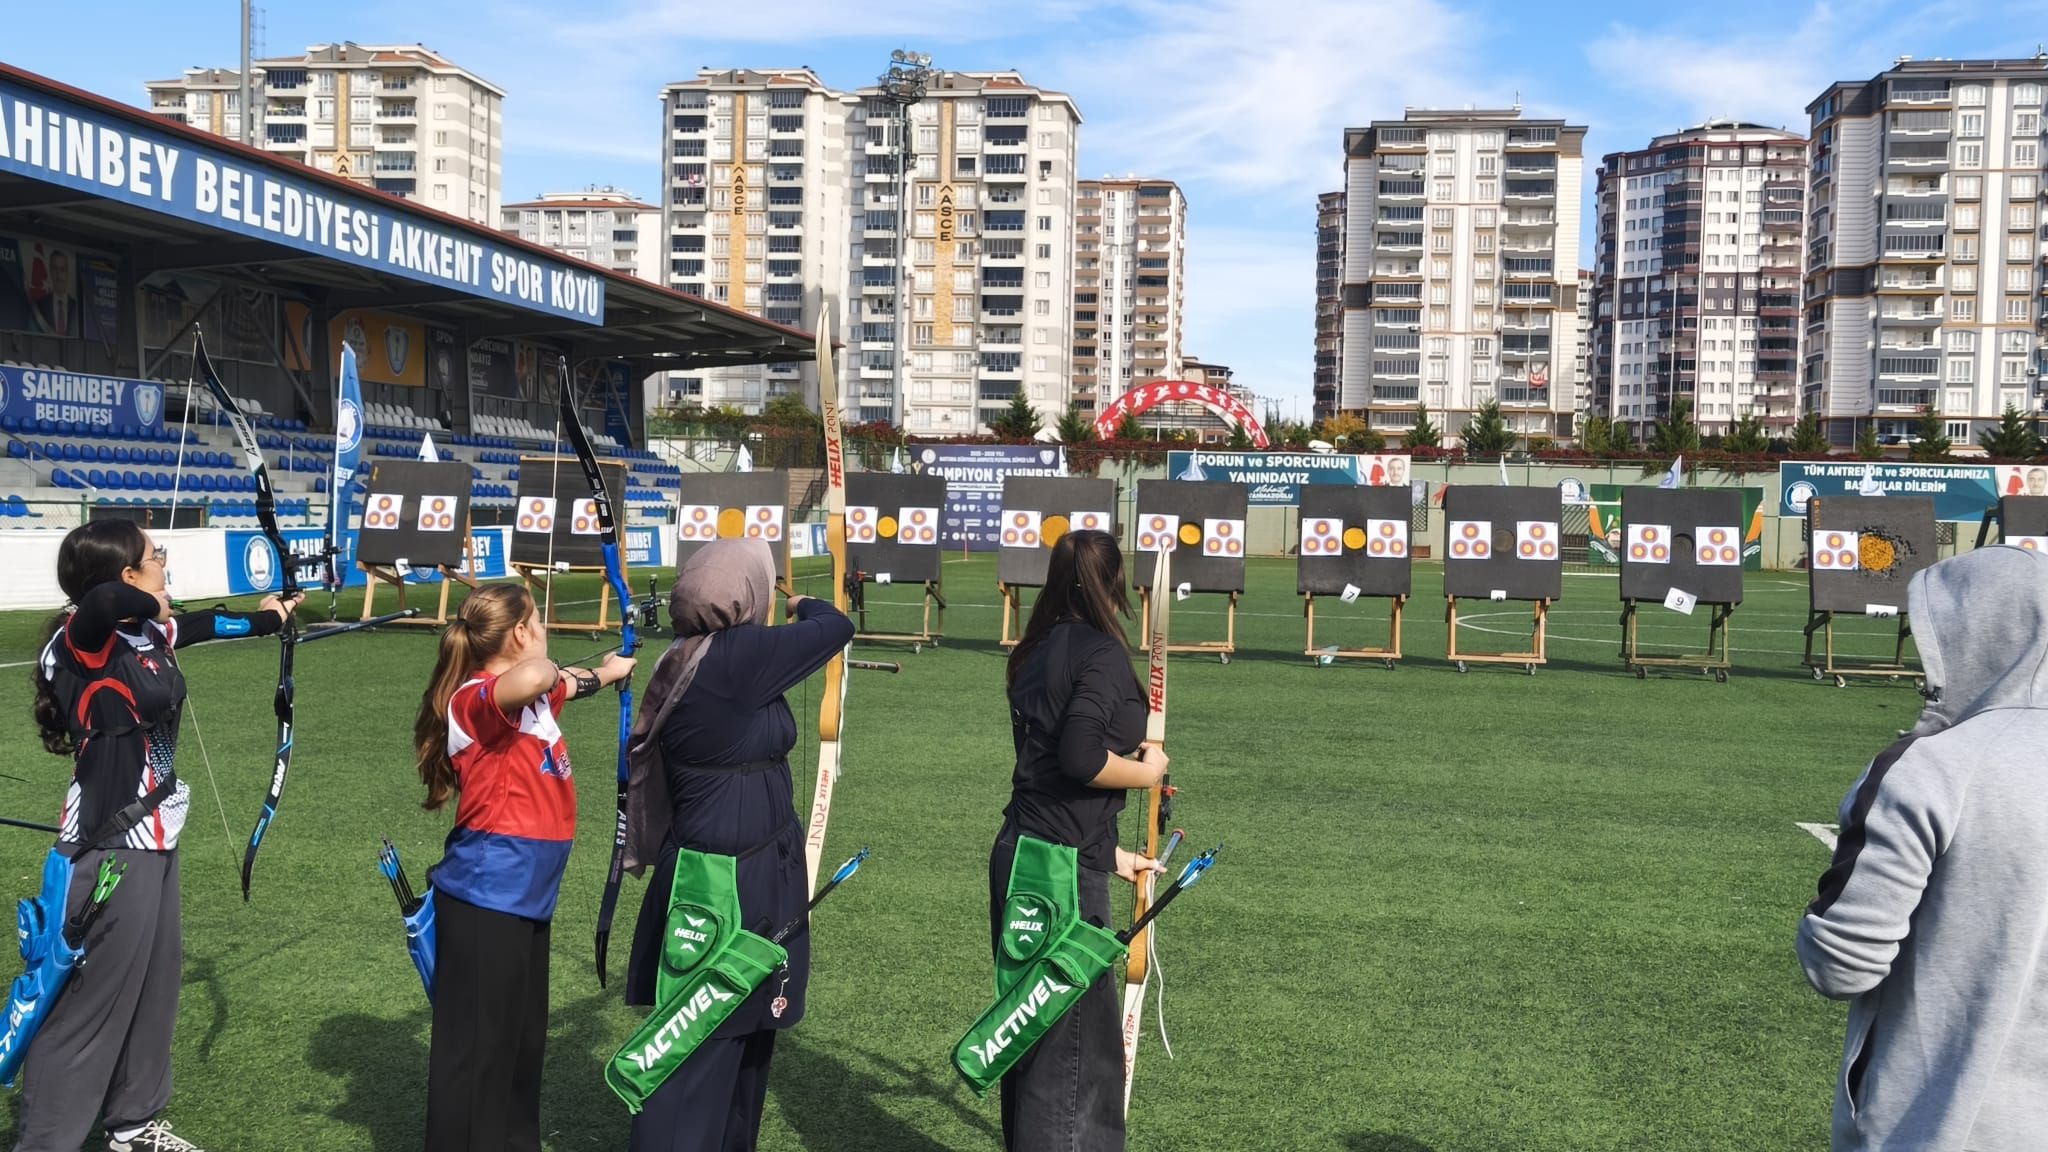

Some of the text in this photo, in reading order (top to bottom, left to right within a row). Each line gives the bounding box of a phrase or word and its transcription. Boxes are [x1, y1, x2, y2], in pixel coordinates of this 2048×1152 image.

[734, 175, 744, 216] ASCE
[940, 194, 953, 242] ASCE
[195, 157, 379, 260] BELEDİYESİ
[388, 221, 483, 286] AKKENT
[491, 252, 544, 304] SPOR
[551, 268, 599, 317] KÖYÜ
[22, 371, 126, 406] ŞAHİNBEY
[35, 402, 113, 426] BELEDİYESİ
[824, 400, 842, 488] HELIX POINT
[1197, 454, 1350, 469] PORUN ve SPORCUNUN
[1229, 471, 1309, 484] YANINDAYIZ
[1803, 464, 1825, 476] TÜM
[1885, 468, 1897, 477] ve
[1899, 467, 1990, 479] SPORCULARIMIZA
[1905, 479, 1946, 492] DİLERİM
[1675, 596, 1685, 607] 9
[1149, 631, 1165, 713] HELIX POINT
[808, 769, 830, 849] HELIX POINT
[674, 927, 707, 943] HELIX
[1009, 920, 1044, 933] HELIX
[644, 985, 714, 1070] ACTIVE
[985, 980, 1051, 1065] ACTIVE
